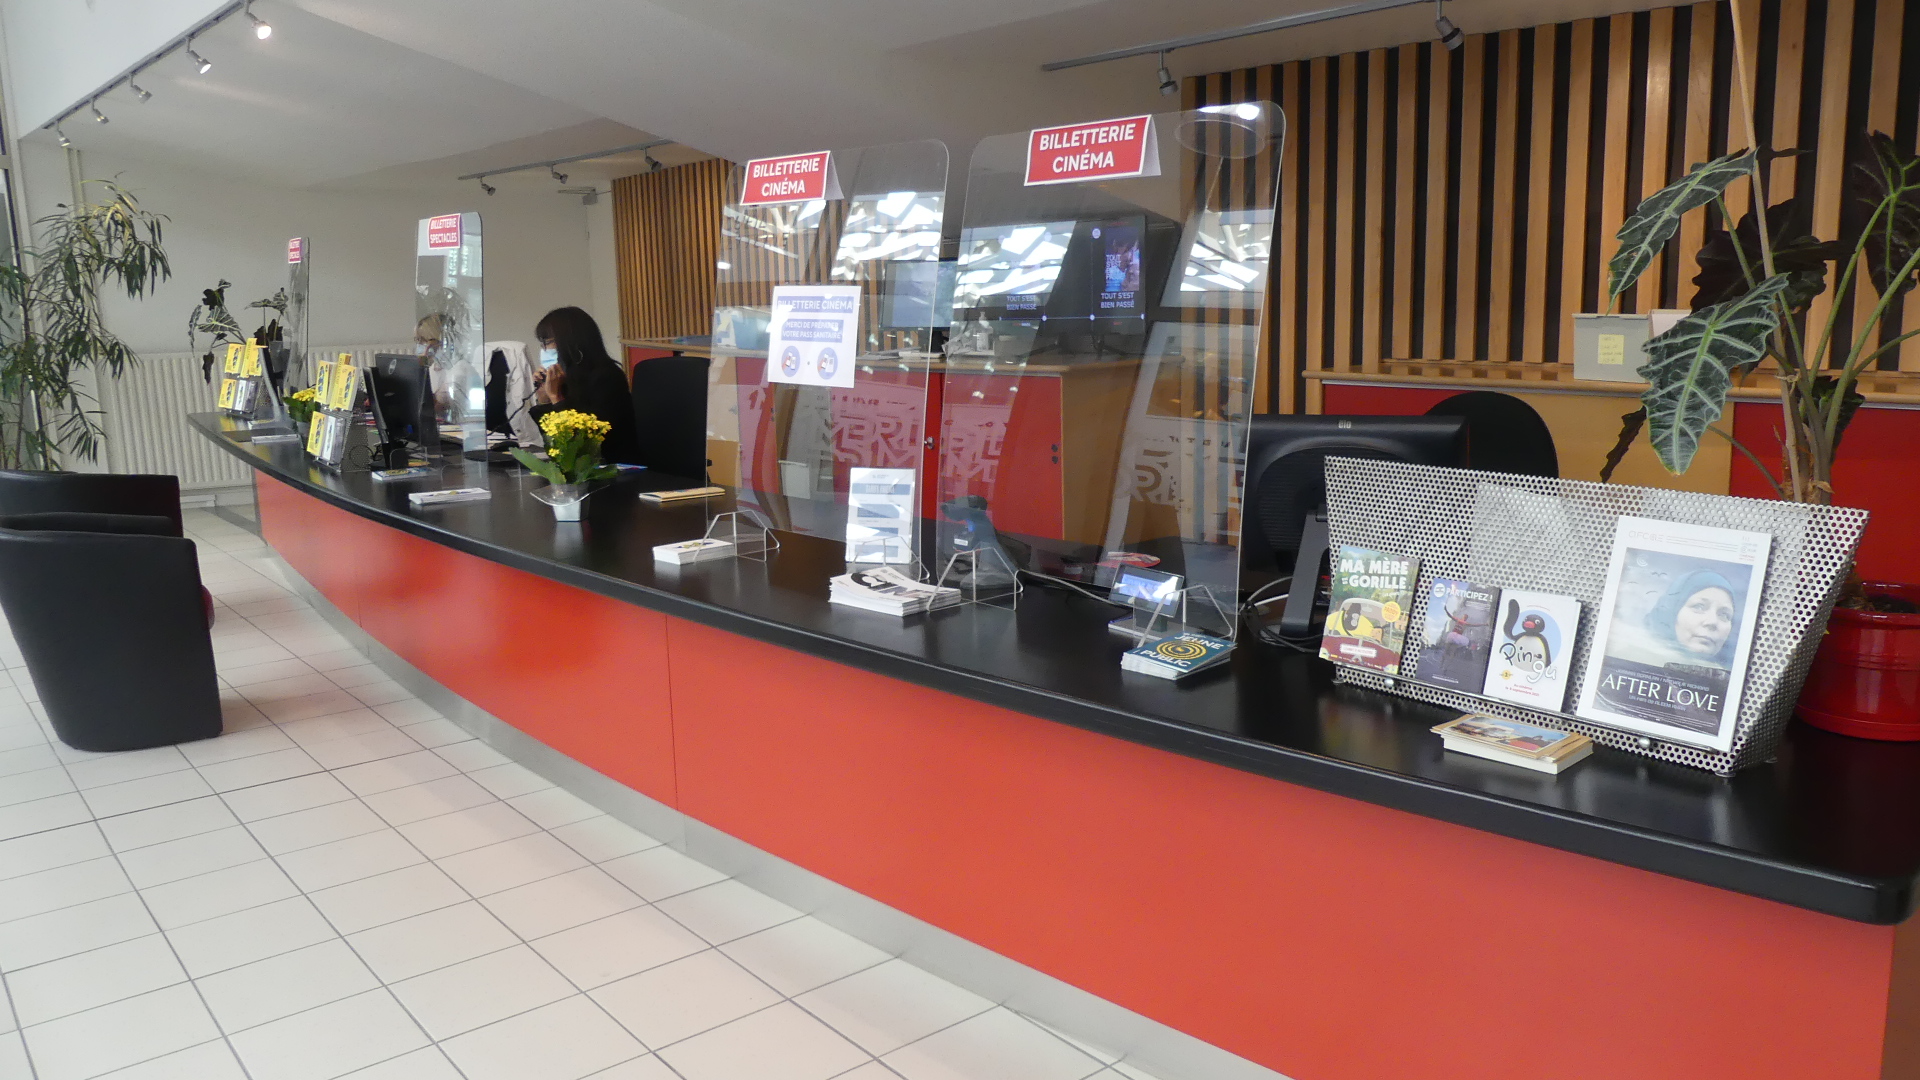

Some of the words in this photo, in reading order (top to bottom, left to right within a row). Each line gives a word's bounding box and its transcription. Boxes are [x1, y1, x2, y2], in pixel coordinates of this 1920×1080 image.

[1039, 123, 1136, 151] BILLETTERIE
[753, 157, 820, 178] BILLETTERIE
[1052, 149, 1114, 173] CINÉMA
[761, 177, 806, 197] CINÉMA
[430, 218, 457, 230] BILLETTERIE
[430, 232, 458, 244] SPECTACLES
[822, 298, 853, 310] CINÉMA
[1116, 300, 1134, 308] PASSÉ
[782, 330, 799, 338] VOTRE
[1340, 558, 1365, 574] MA
[1368, 556, 1409, 575] MÈRE
[1348, 574, 1407, 589] GORILLE
[1446, 588, 1488, 602] PARTICIPEZ
[1174, 634, 1224, 650] JEUNE
[1140, 650, 1192, 667] PUBLIC
[1601, 673, 1660, 700] AFTER
[1666, 686, 1719, 712] LOVE
